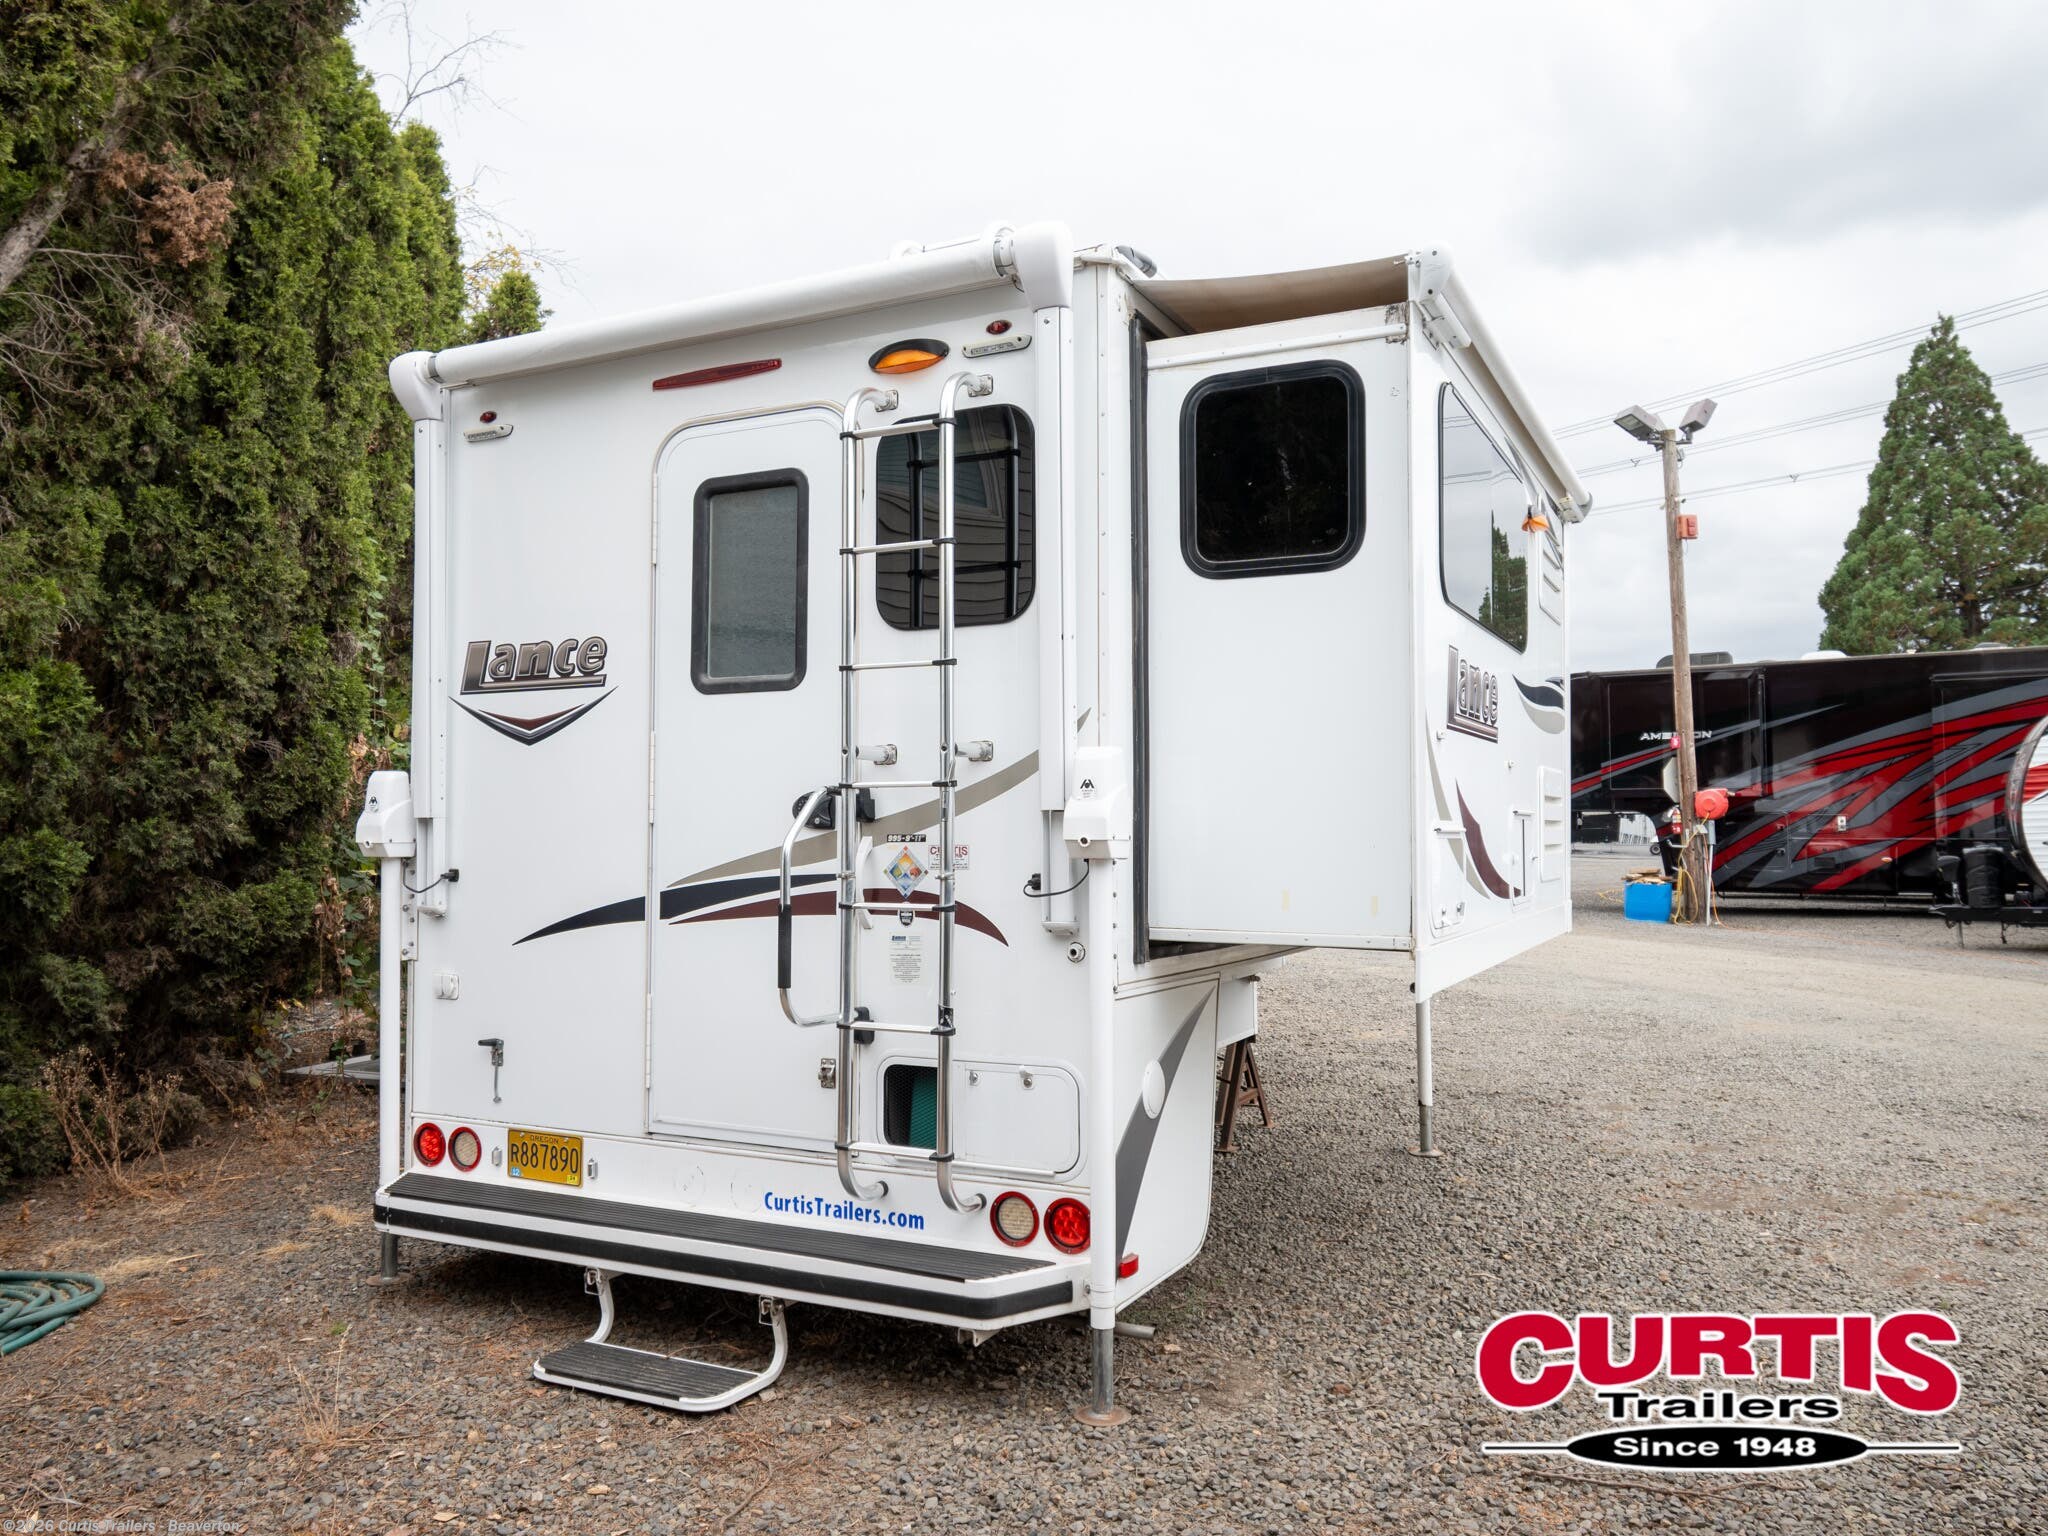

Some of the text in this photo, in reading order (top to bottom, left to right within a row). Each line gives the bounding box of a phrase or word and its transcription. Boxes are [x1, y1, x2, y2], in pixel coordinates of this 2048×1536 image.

[460, 636, 608, 695] Lance
[1447, 644, 1499, 744] Lance
[511, 1141, 579, 1174] R887890
[764, 1191, 925, 1230] CurtisTrailers.com
